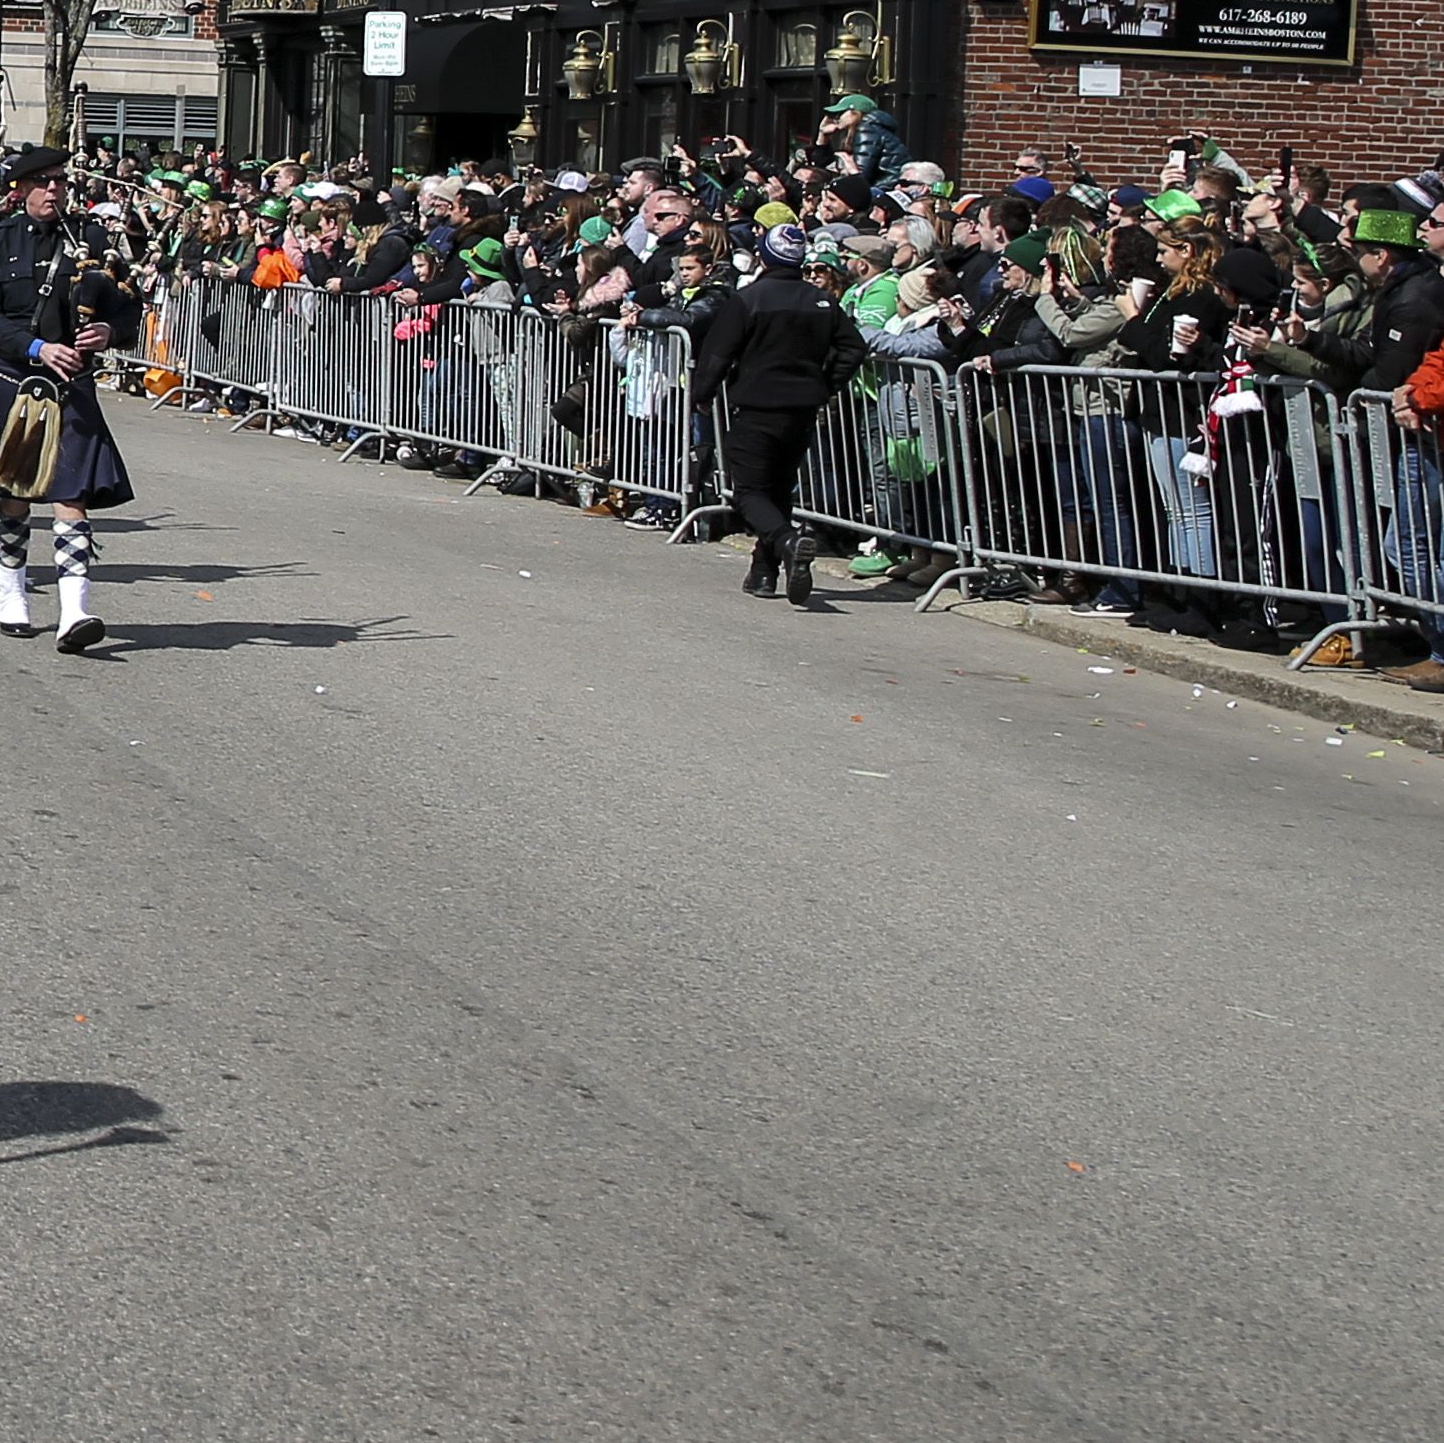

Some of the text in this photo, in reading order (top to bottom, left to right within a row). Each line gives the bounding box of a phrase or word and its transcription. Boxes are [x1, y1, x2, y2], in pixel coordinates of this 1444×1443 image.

[1218, 7, 1308, 26] 617-268-6189
[368, 20, 402, 30] Parking
[370, 30, 399, 39] 2 Hour
[373, 41, 395, 50] Limit
